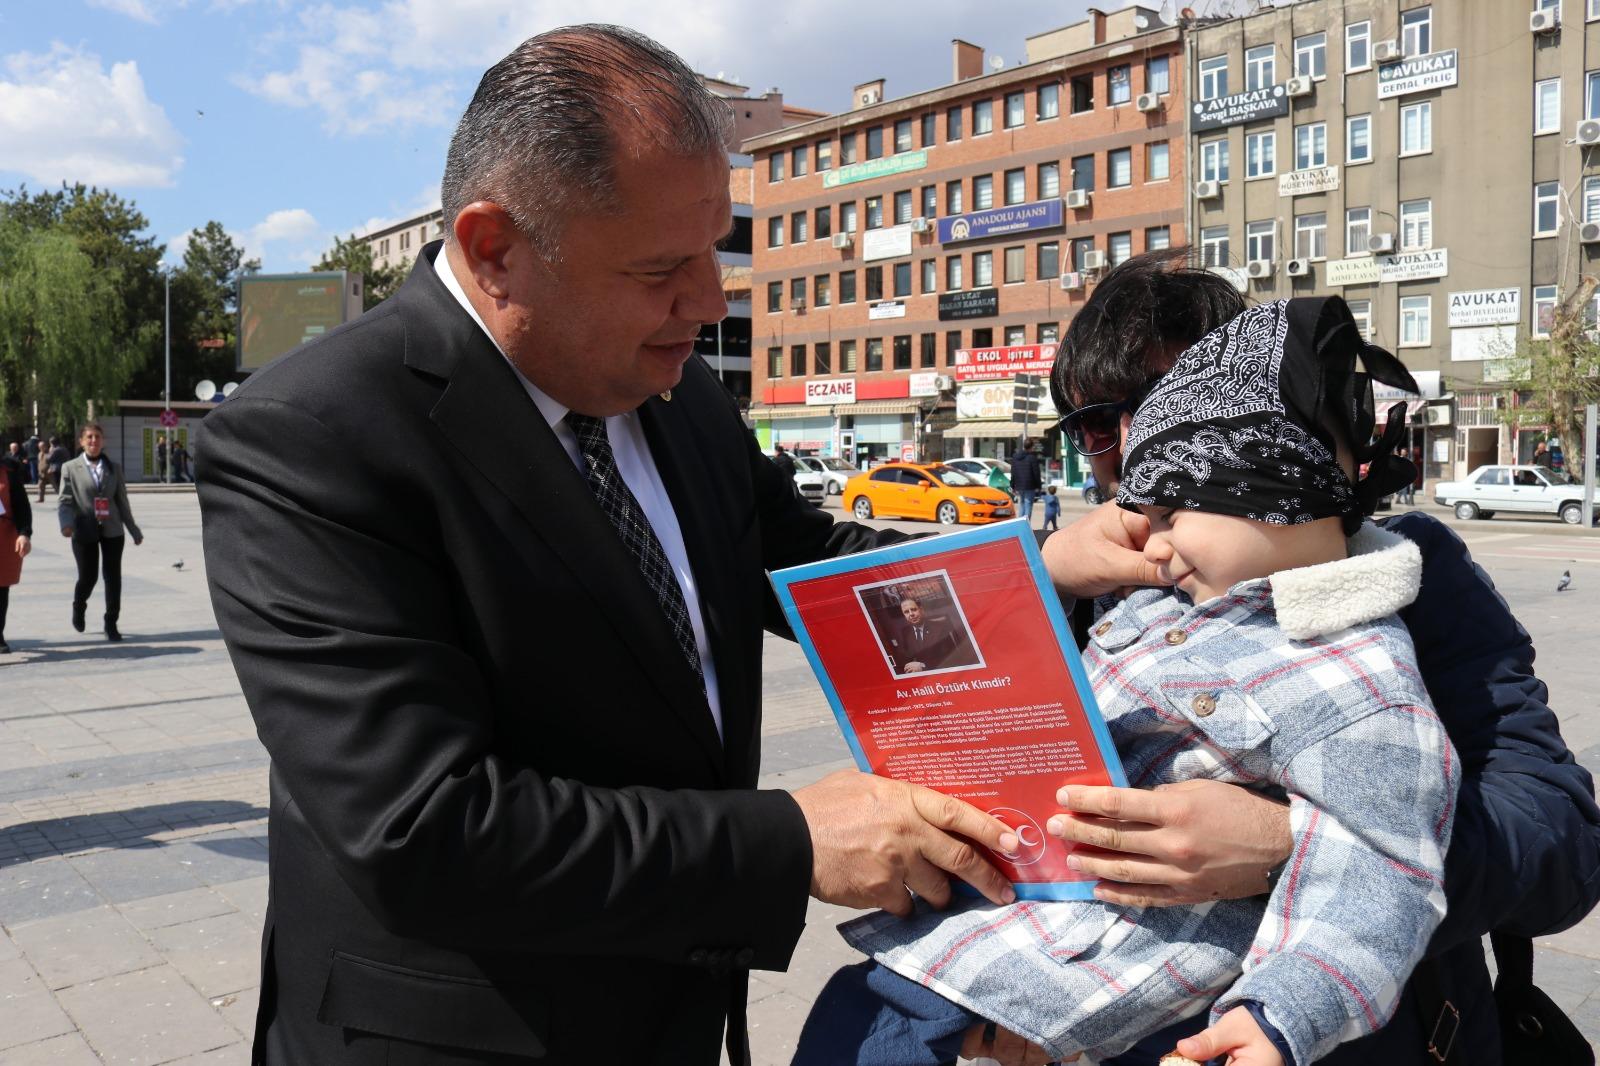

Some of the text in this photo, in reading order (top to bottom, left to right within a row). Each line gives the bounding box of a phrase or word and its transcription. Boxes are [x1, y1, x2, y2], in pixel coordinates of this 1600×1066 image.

[1392, 54, 1453, 78] AVUKAT
[1382, 80, 1418, 93] CEMAL
[1208, 88, 1270, 111] AVUKAT
[1200, 109, 1227, 122] Sevgi
[1230, 99, 1278, 116] BAŞKAYA
[1291, 170, 1328, 180] AVUKAT
[972, 206, 1046, 226] ANADOLU AJANSI
[1386, 252, 1442, 264] AVUKAT
[1452, 291, 1517, 307] AVUKAT
[976, 351, 1002, 361] EKOL
[958, 365, 976, 374] SATIŞ
[987, 362, 1024, 371] UYGULAMA
[1026, 360, 1054, 368] MERKEZ
[808, 382, 852, 396] ECZANE
[896, 676, 1011, 698] Av. Halil Öztürk Kimdir?
